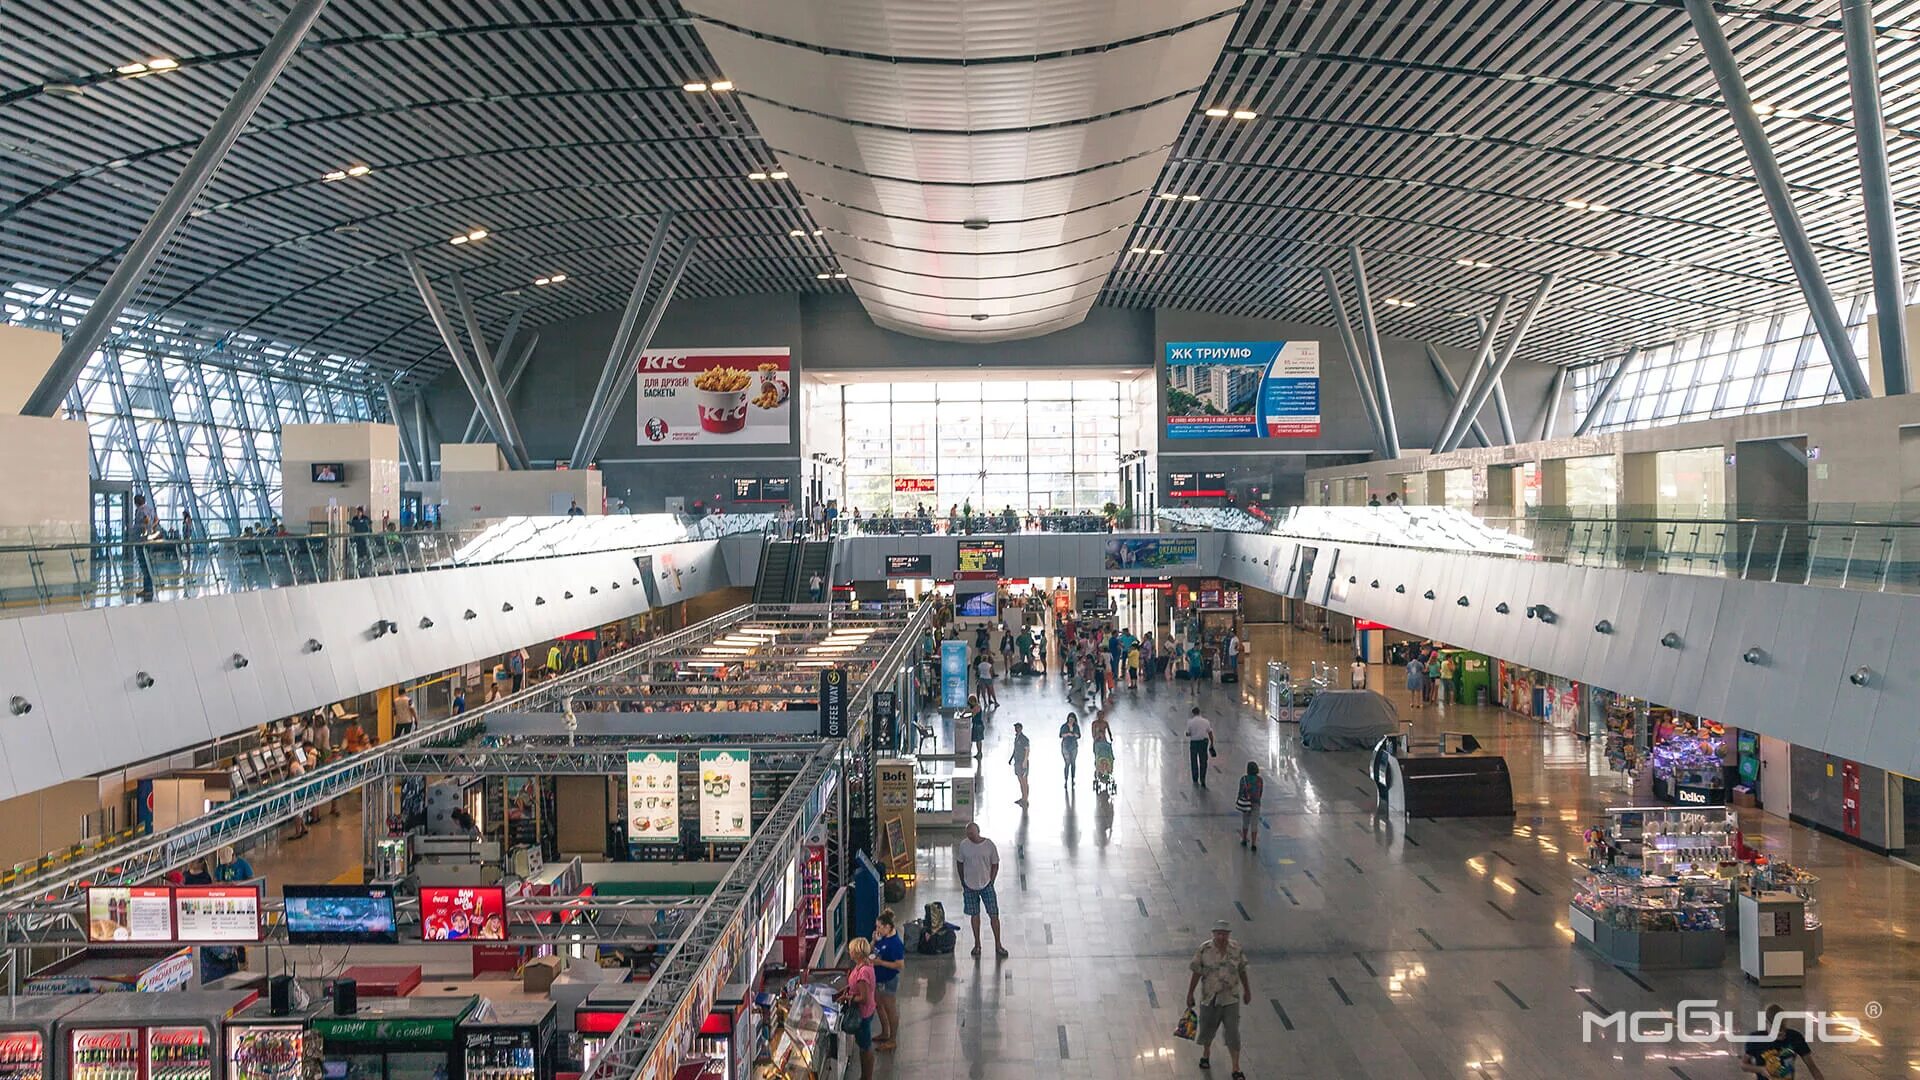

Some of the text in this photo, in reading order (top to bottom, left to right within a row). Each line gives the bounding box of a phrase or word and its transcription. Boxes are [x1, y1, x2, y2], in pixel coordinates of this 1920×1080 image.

[1171, 347, 1252, 359] ЖК ТРИУМФ
[644, 356, 687, 369] KFC
[644, 376, 690, 388] ДЛЯ ДРУЗЕЙ!
[644, 388, 676, 398] БАСКЕТЫ
[703, 405, 746, 421] KFC
[829, 684, 839, 736] COFFEE WAY
[882, 770, 907, 781] Boft
[331, 1021, 366, 1034] ВОЗЬМИ
